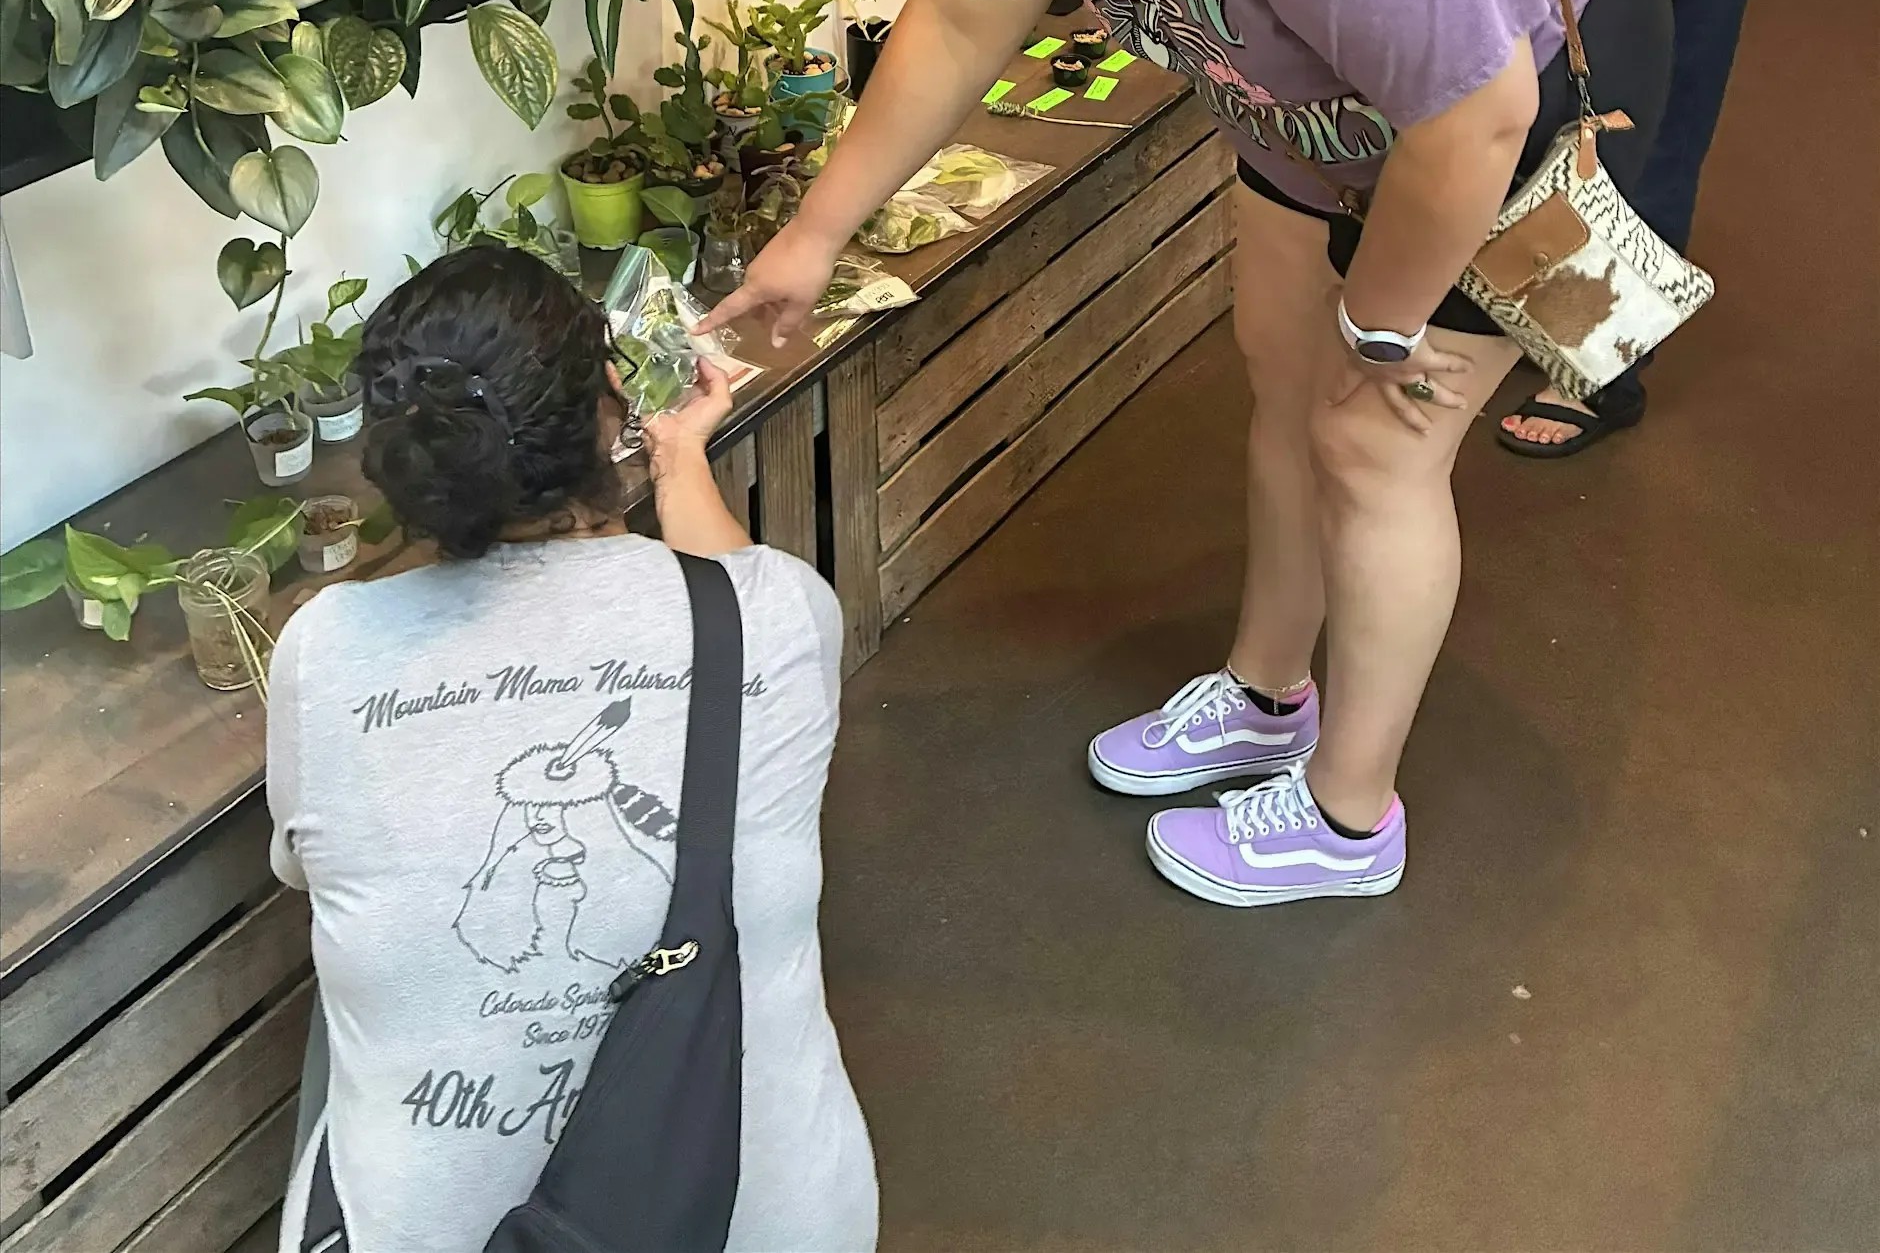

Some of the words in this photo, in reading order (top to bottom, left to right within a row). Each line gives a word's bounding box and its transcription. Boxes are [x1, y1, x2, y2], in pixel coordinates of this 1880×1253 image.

[352, 681, 481, 733] Mountain
[486, 665, 584, 701] Mama
[479, 989, 560, 1018] Colorado
[523, 1021, 570, 1048] Since
[401, 1069, 497, 1129] 40th
